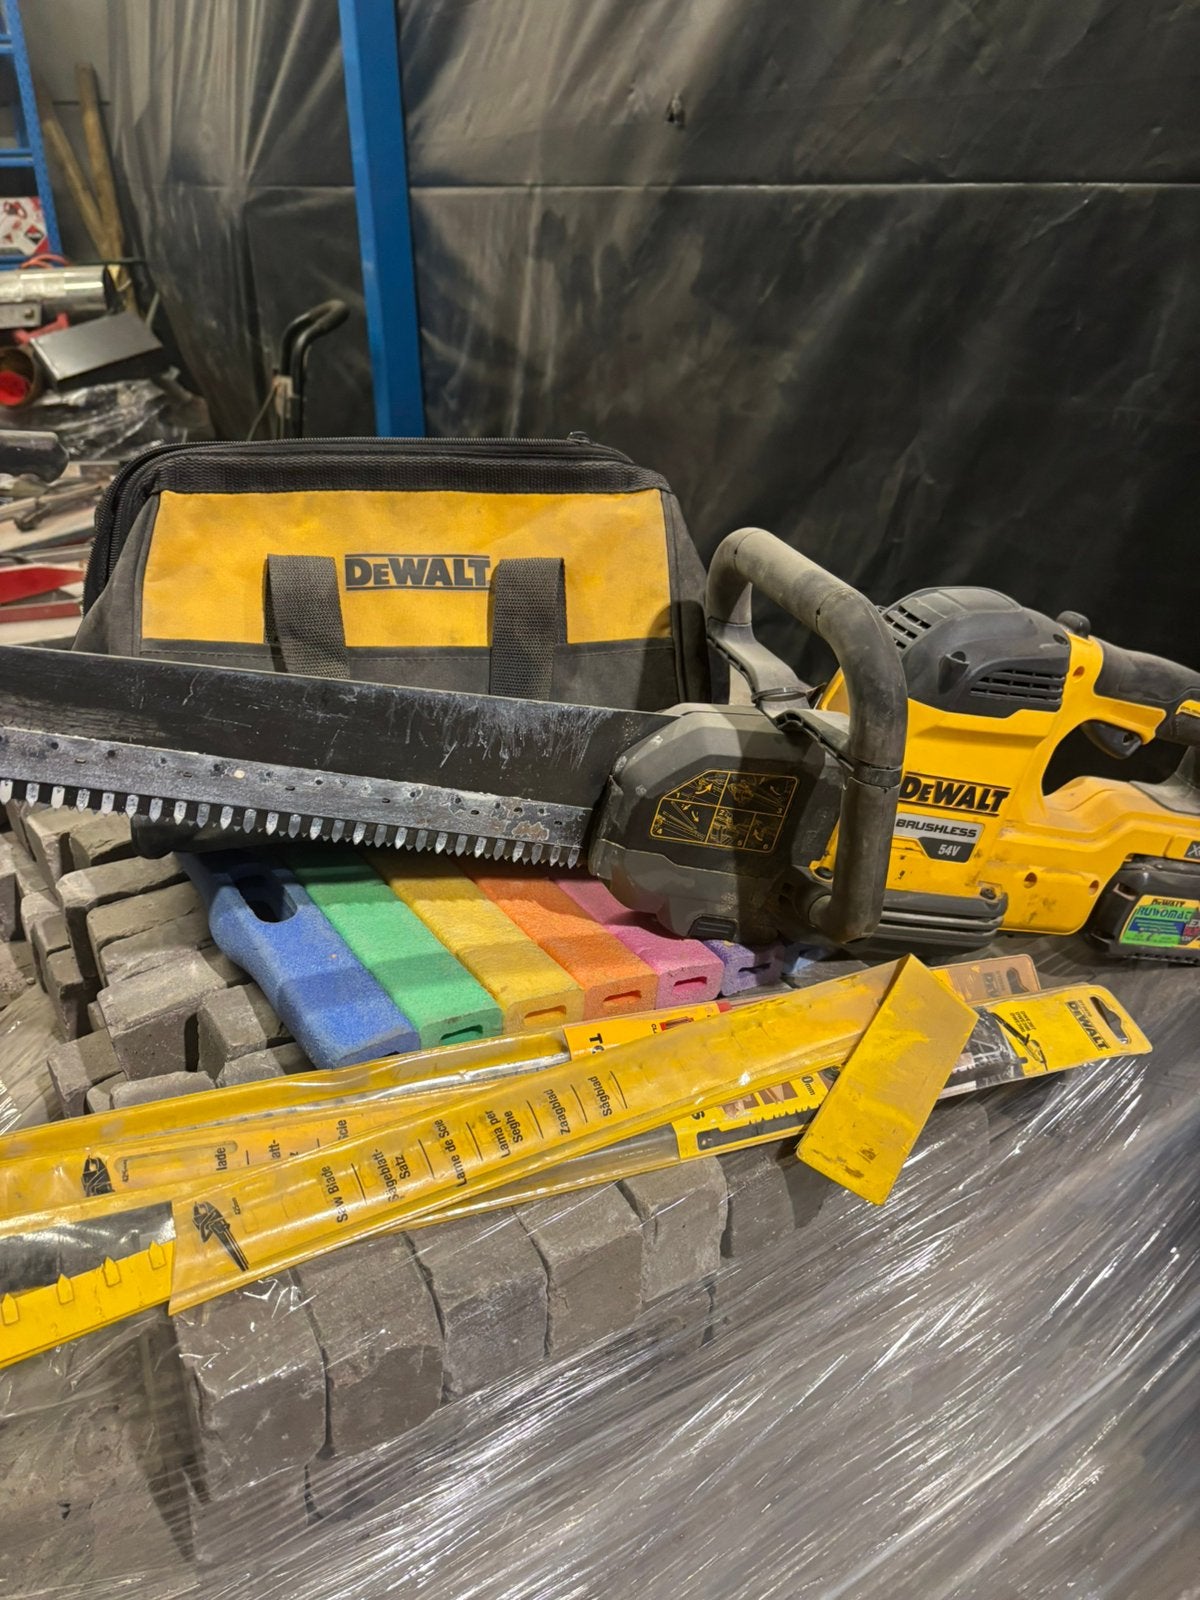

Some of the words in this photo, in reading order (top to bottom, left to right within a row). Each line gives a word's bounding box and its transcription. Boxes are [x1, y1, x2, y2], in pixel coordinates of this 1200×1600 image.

[896, 818, 977, 838] BRUSHLESS
[938, 844, 961, 856] 54V
[485, 1110, 502, 1126] per
[544, 1088, 571, 1135] Zaagblad
[435, 1119, 450, 1138] Scie
[504, 1110, 523, 1143] Seghe
[444, 1139, 456, 1152] de
[494, 1127, 511, 1158] Lama
[215, 1147, 228, 1171] lade
[395, 1154, 411, 1179] Satz
[451, 1154, 467, 1187] Lame
[321, 1166, 339, 1194] Blade
[333, 1196, 348, 1223] Saw
